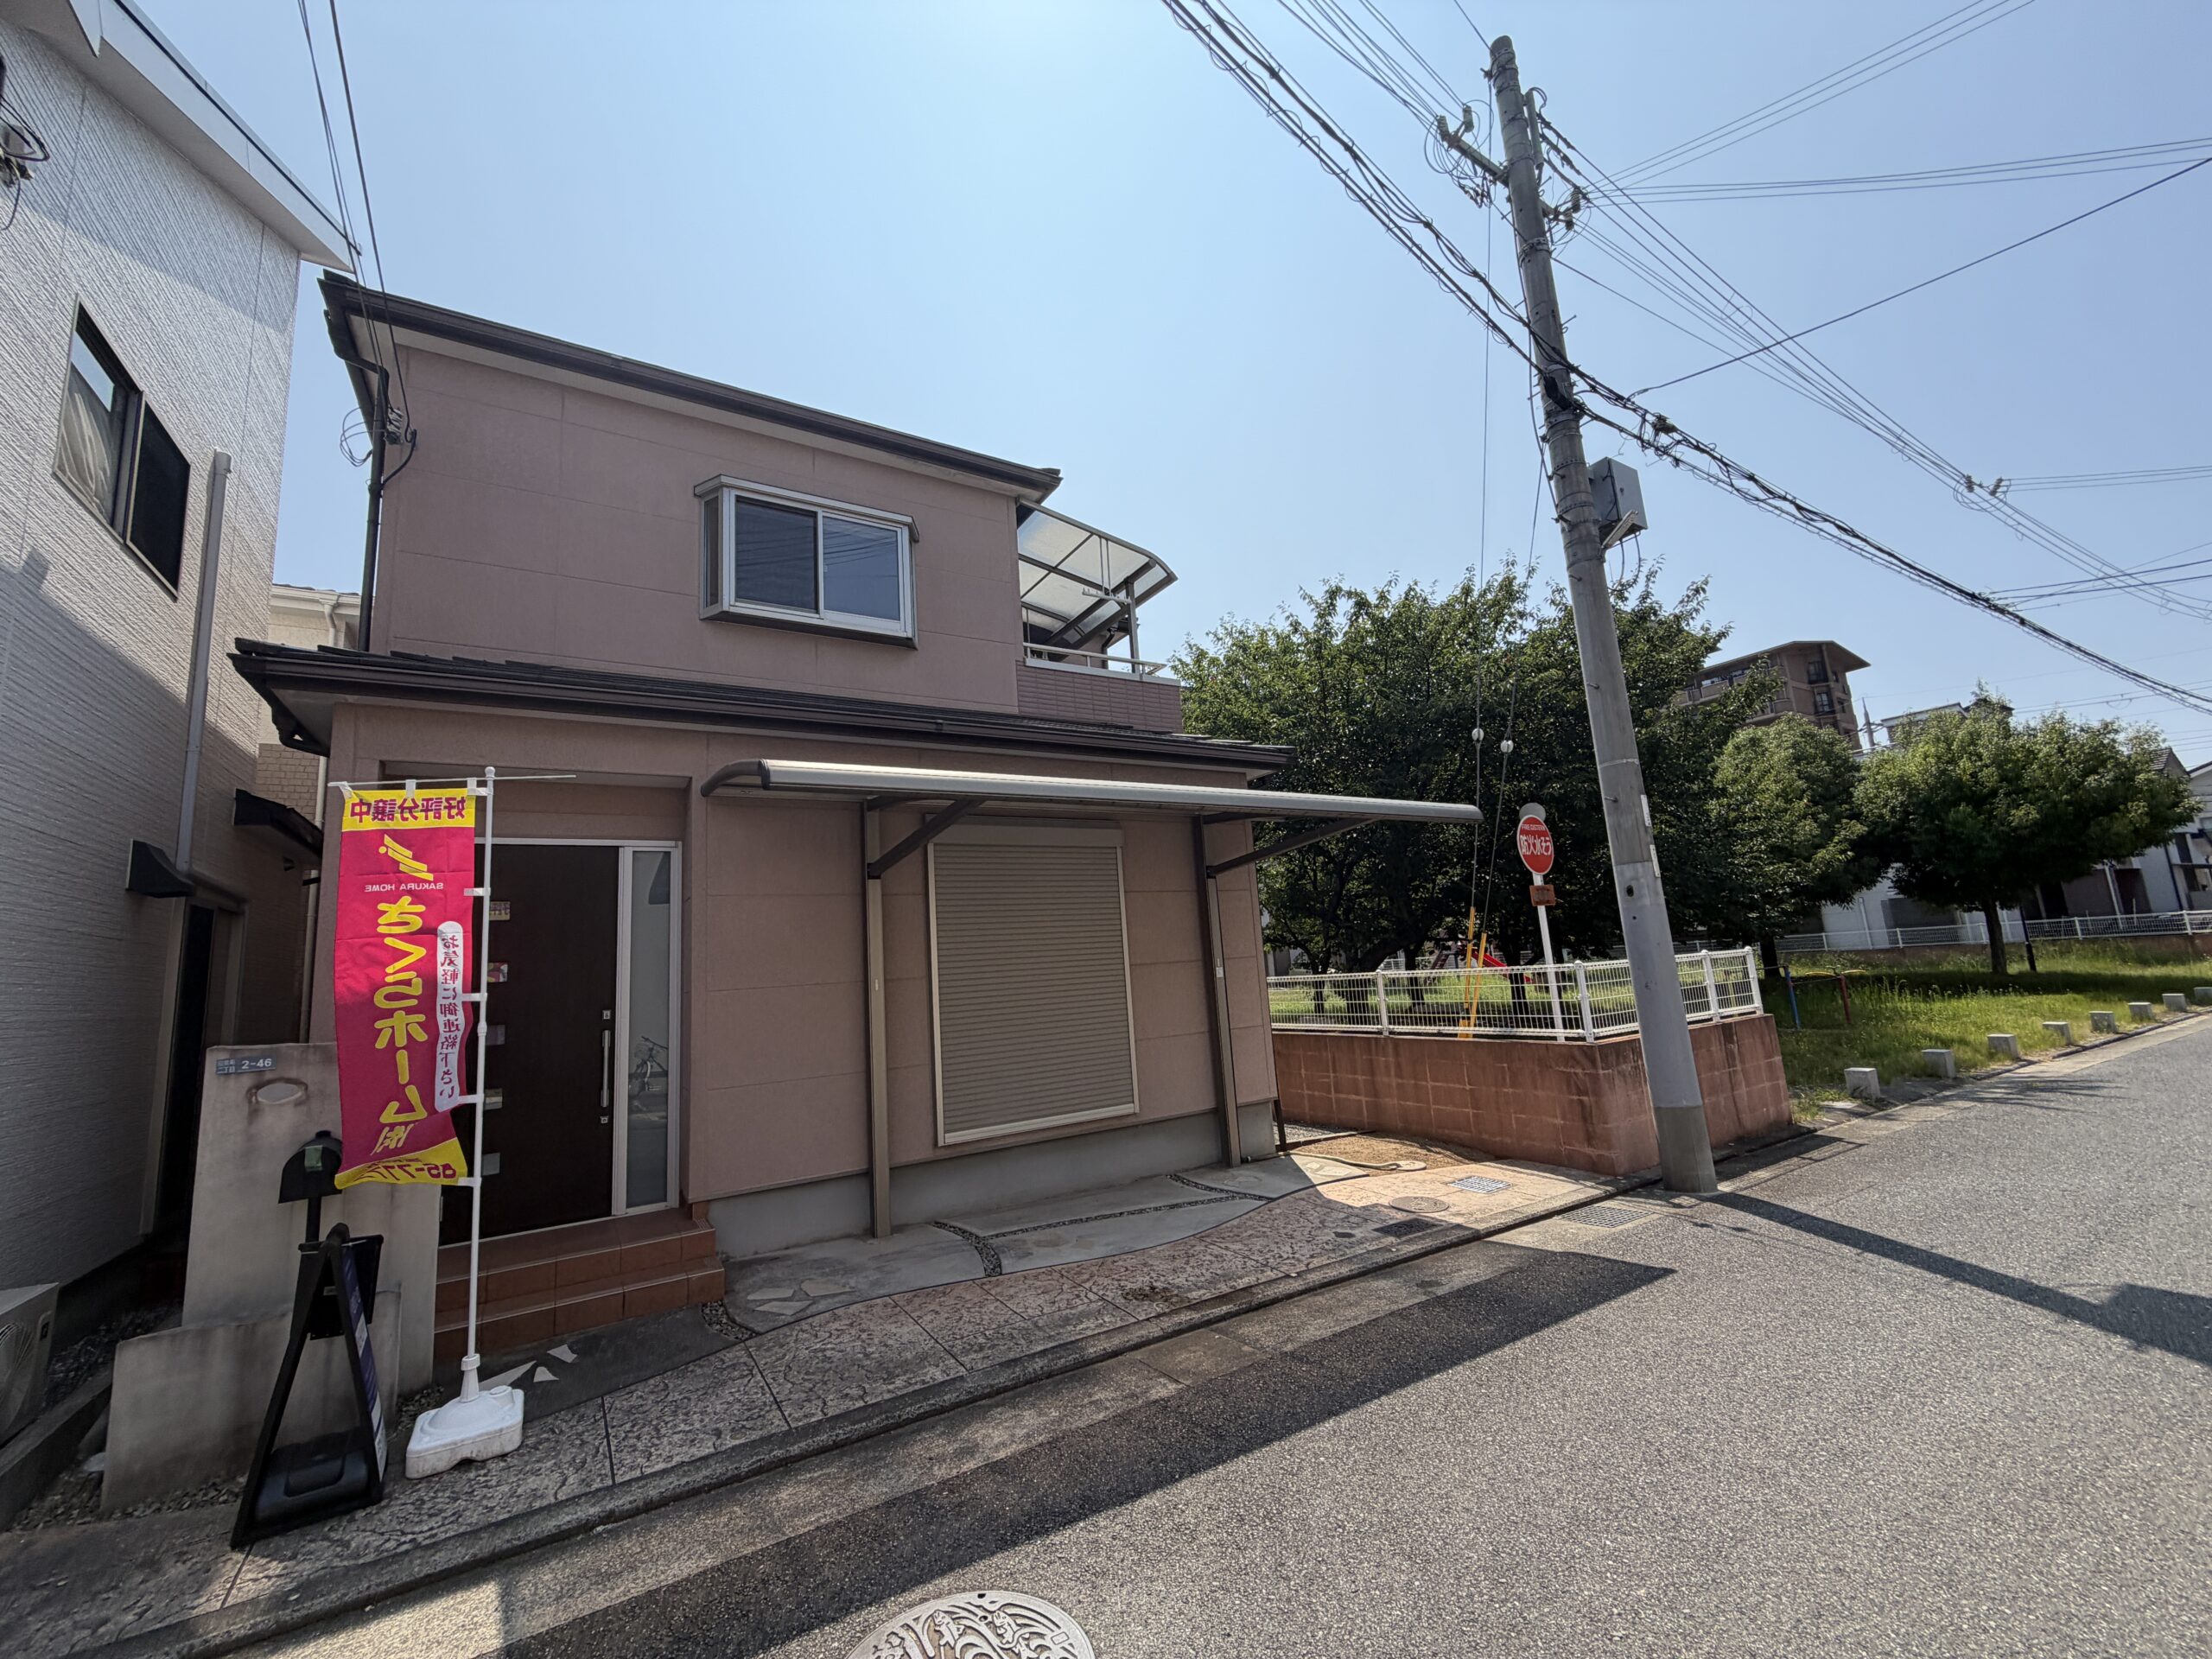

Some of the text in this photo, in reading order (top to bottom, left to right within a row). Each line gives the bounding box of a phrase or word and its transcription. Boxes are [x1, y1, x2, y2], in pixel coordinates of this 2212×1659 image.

[1520, 834, 1553, 855] 防火水そう
[242, 1058, 272, 1070] 2-46
